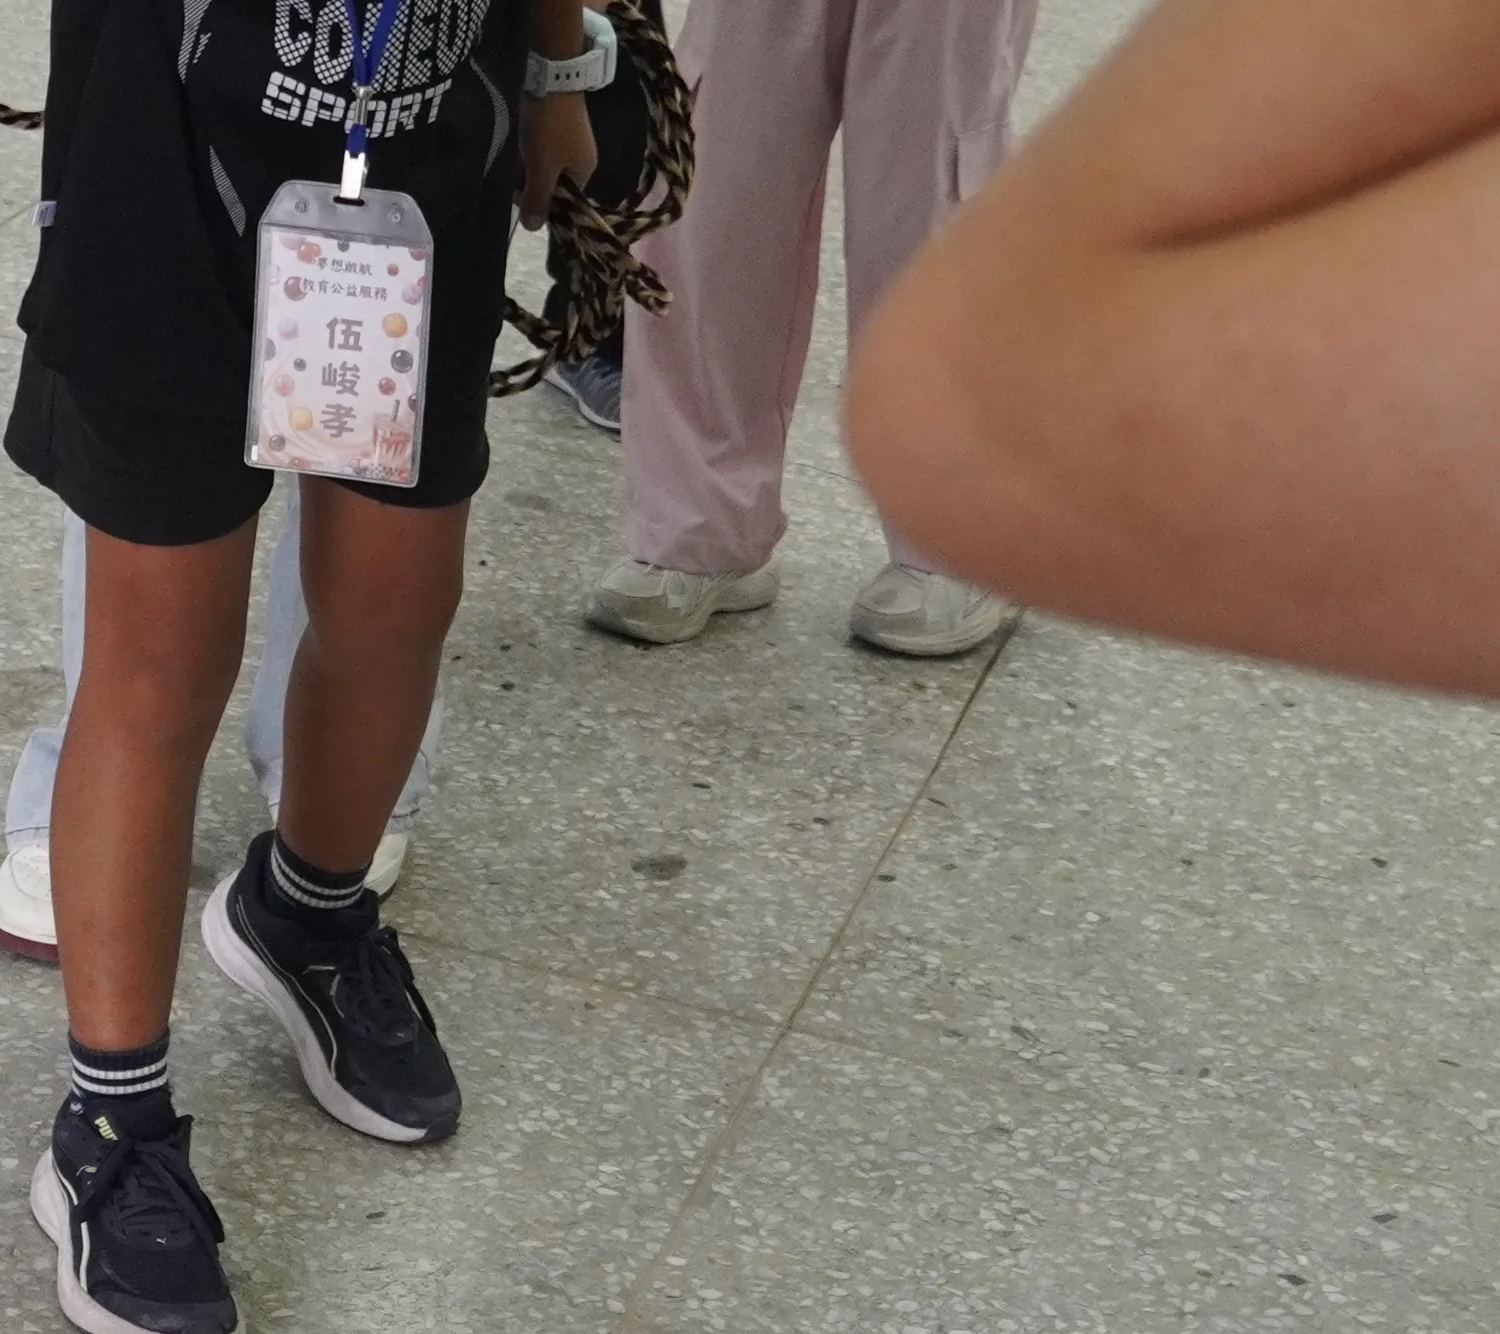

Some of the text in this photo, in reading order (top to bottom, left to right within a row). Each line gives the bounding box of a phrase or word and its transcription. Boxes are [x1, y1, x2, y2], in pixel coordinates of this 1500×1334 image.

[260, 70, 452, 139] SPORT
[320, 316, 364, 438] 伍峻孝
